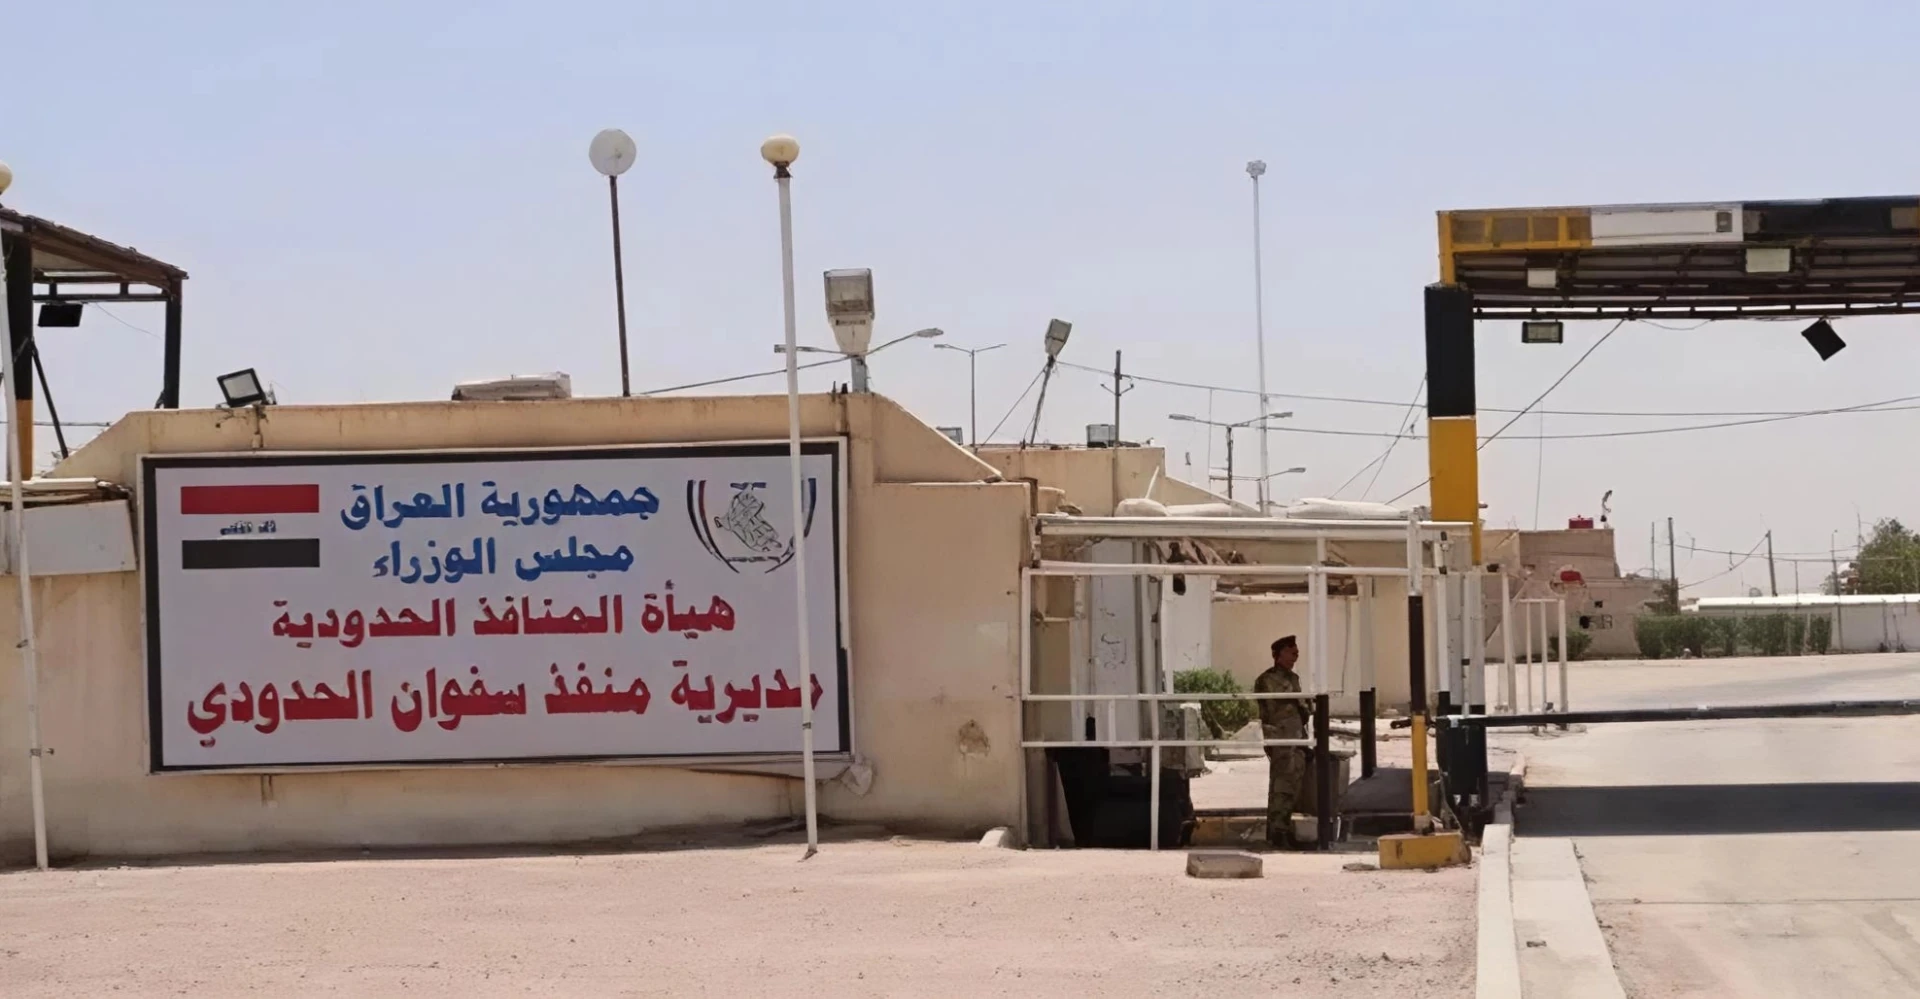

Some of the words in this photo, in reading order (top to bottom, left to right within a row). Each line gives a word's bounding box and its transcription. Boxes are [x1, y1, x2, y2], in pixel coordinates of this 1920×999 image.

[341, 483, 464, 530] العراق
[481, 481, 659, 526] جمهورية
[373, 537, 495, 584] الوزراء
[515, 536, 634, 581] مجلس
[273, 598, 456, 648] الحدودية
[474, 595, 623, 635] المنافذ
[641, 580, 735, 639] هيأة
[188, 670, 373, 747] الحدودي
[391, 666, 527, 732] سفوان
[544, 663, 651, 715] منفذ
